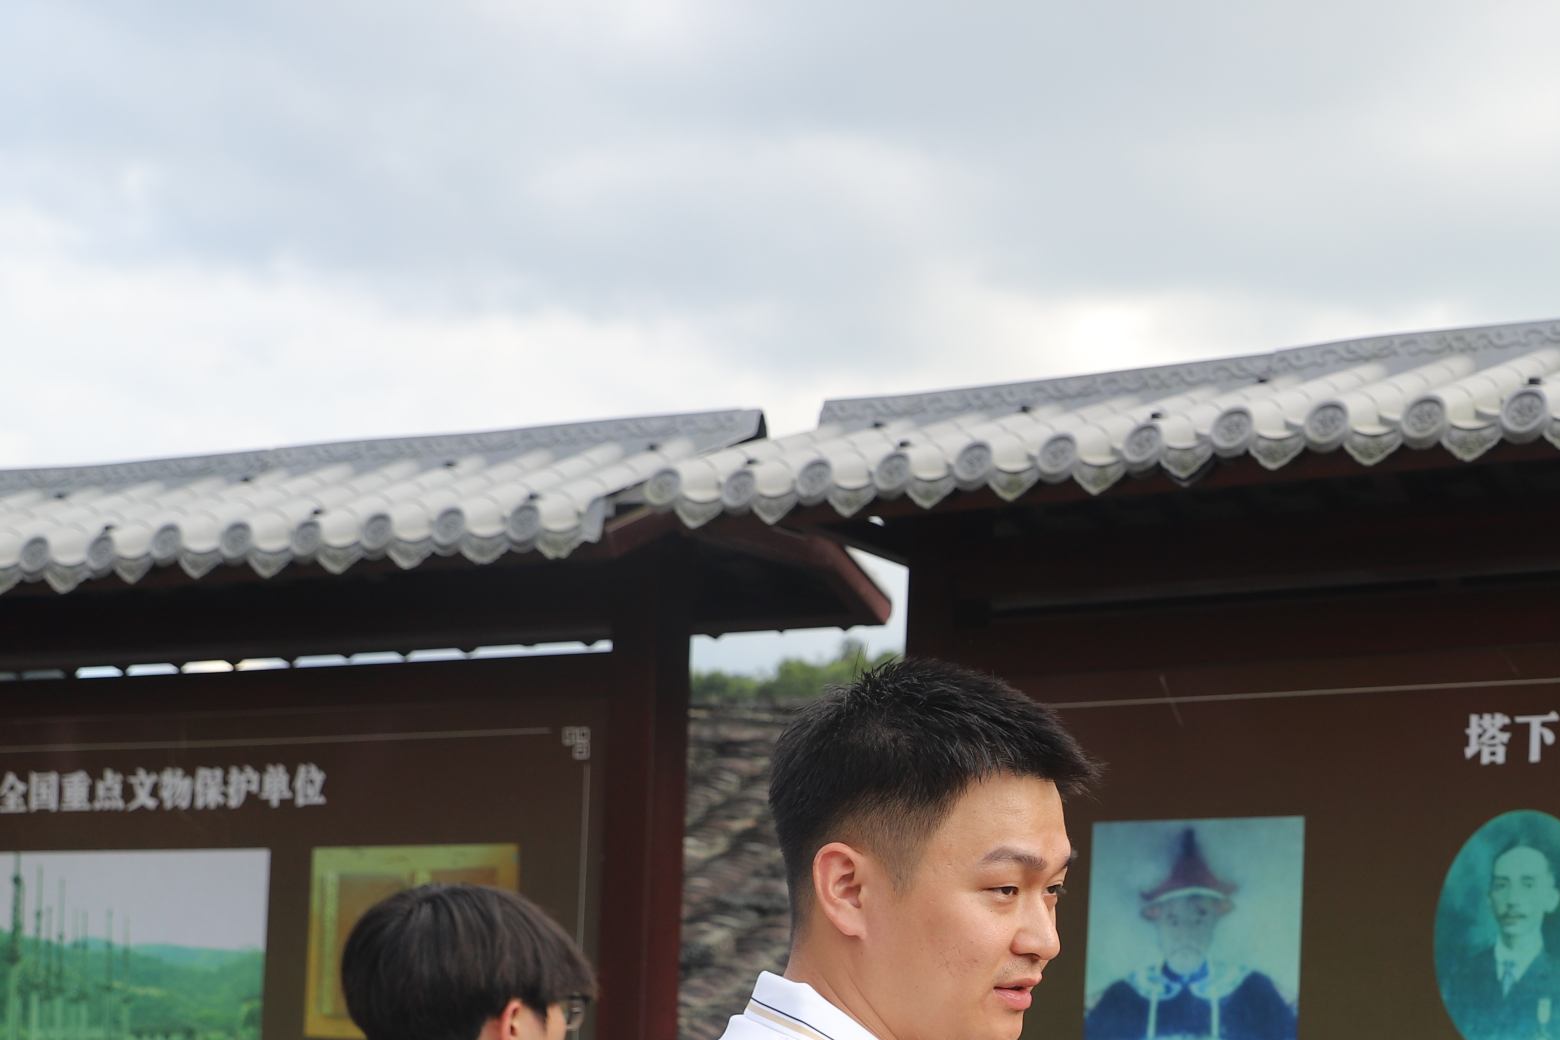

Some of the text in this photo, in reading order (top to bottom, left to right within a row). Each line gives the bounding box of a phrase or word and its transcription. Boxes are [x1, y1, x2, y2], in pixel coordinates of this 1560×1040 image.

[0, 764, 327, 813] 全国重点文物保护单位
